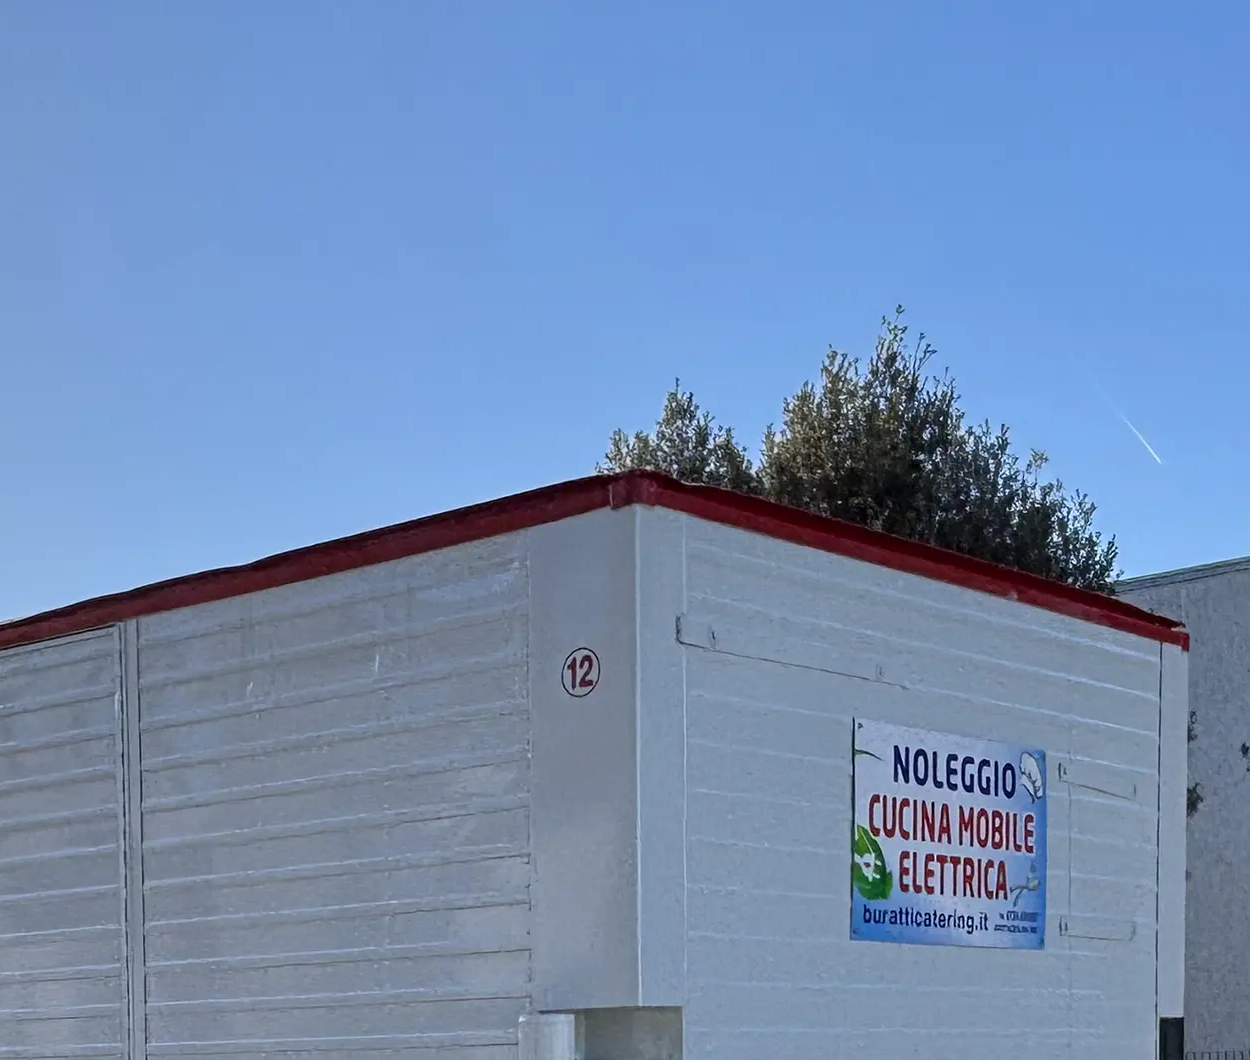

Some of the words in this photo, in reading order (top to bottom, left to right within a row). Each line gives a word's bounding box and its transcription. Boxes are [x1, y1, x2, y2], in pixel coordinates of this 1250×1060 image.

[567, 655, 594, 691] 12
[893, 745, 1017, 799] NOLEGGIO
[868, 794, 952, 845] CUCINA
[958, 805, 1035, 853] MOBILE
[899, 850, 1009, 900] ELETTRICA
[863, 905, 988, 934] buratticatering.it
